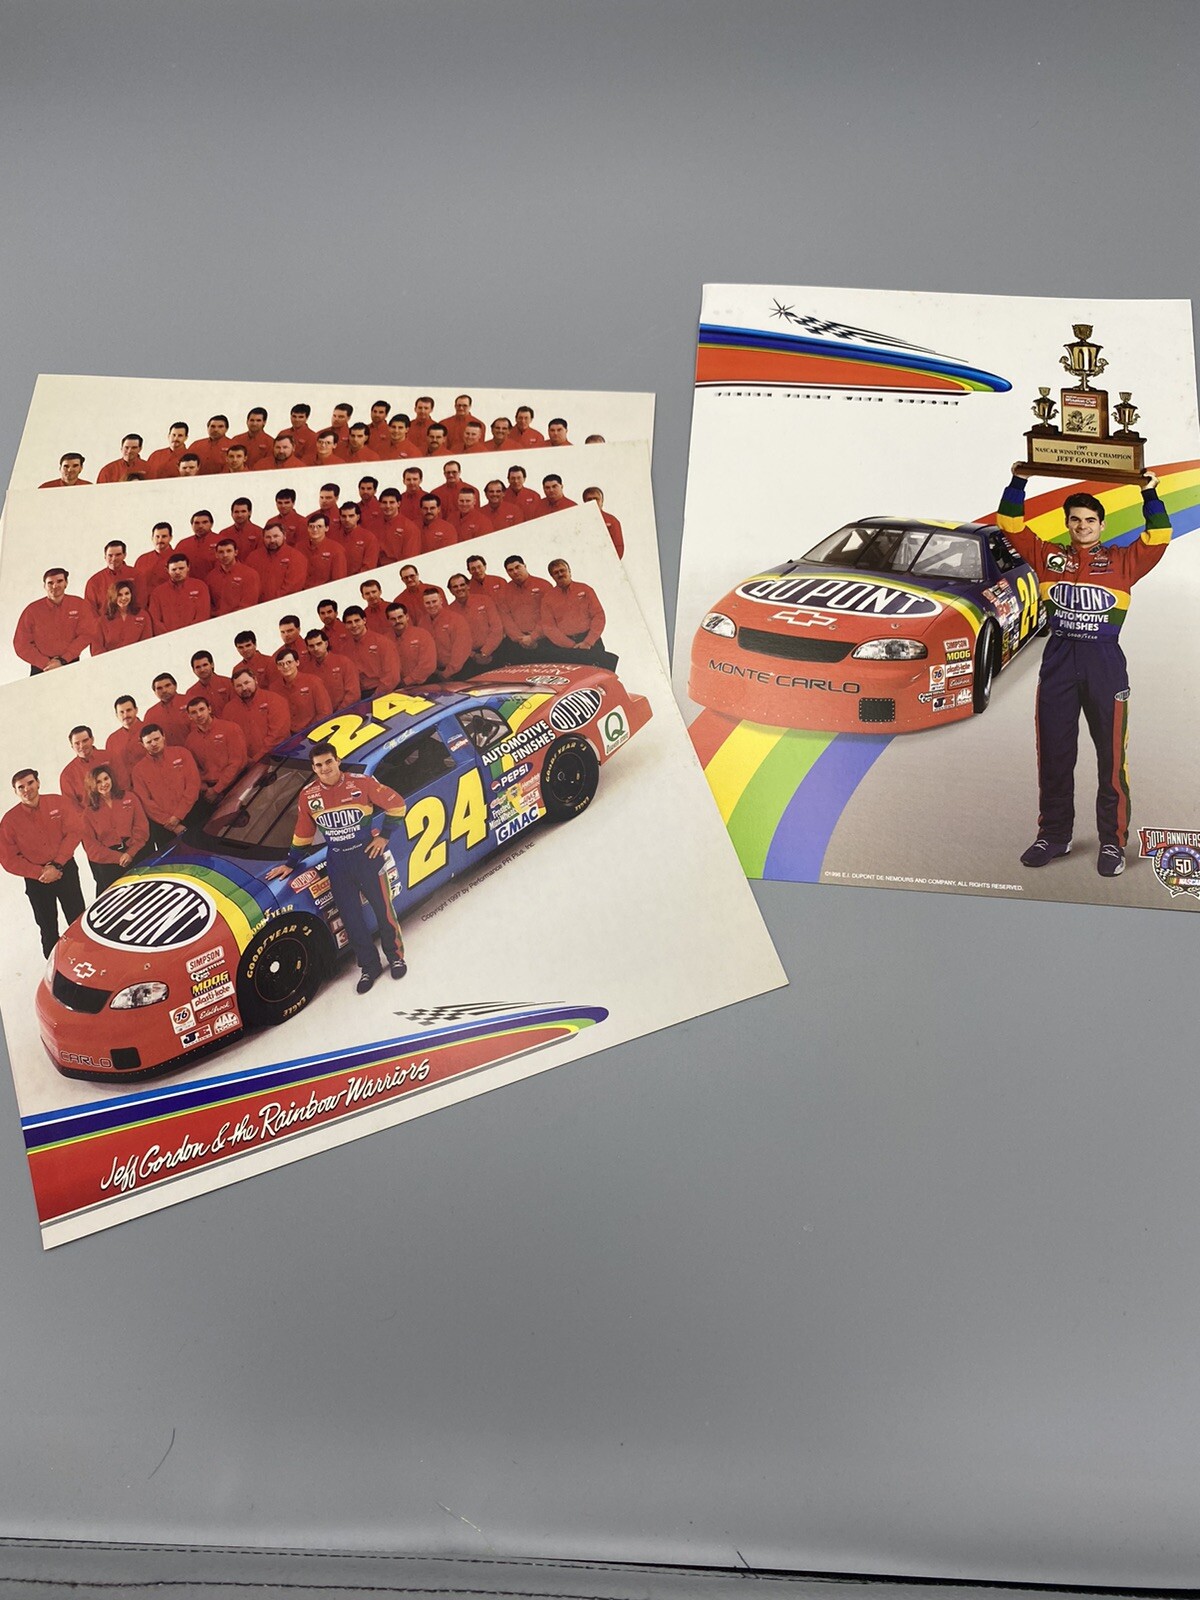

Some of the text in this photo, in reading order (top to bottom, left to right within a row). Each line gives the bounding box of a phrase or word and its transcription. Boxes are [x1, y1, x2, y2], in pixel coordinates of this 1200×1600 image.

[1075, 457, 1110, 465] GORDON
[1054, 609, 1109, 623] AUTOMOTIVE
[1059, 620, 1099, 631] FINISHES
[946, 650, 971, 661] MOOG
[709, 659, 861, 694] MONTE CARLO
[307, 692, 436, 760] 24
[481, 719, 550, 766] AUTOMOTIVE
[511, 730, 556, 763] FINISHES
[501, 763, 529, 787] PEPSI
[325, 825, 361, 836] AUTOMOTIVE
[405, 767, 487, 888] 24
[498, 806, 538, 841] GMAC
[329, 833, 356, 842] FINISHES
[1175, 859, 1191, 873] 50
[421, 902, 448, 921] Copyright
[448, 892, 461, 903] 1997
[461, 886, 470, 895] by
[468, 864, 503, 888] Performance
[885, 875, 914, 883] NEMOURS
[957, 880, 968, 888] ALL
[968, 881, 990, 889] RIGHTS
[189, 949, 220, 970] SIMPSON
[246, 924, 297, 978] GOODYEAR
[192, 971, 229, 993] MOOG
[176, 1010, 188, 1021] 76
[60, 1050, 112, 1068] CARLO
[100, 1059, 430, 1192] Jeff Gordon & the Rainbow Warriors
